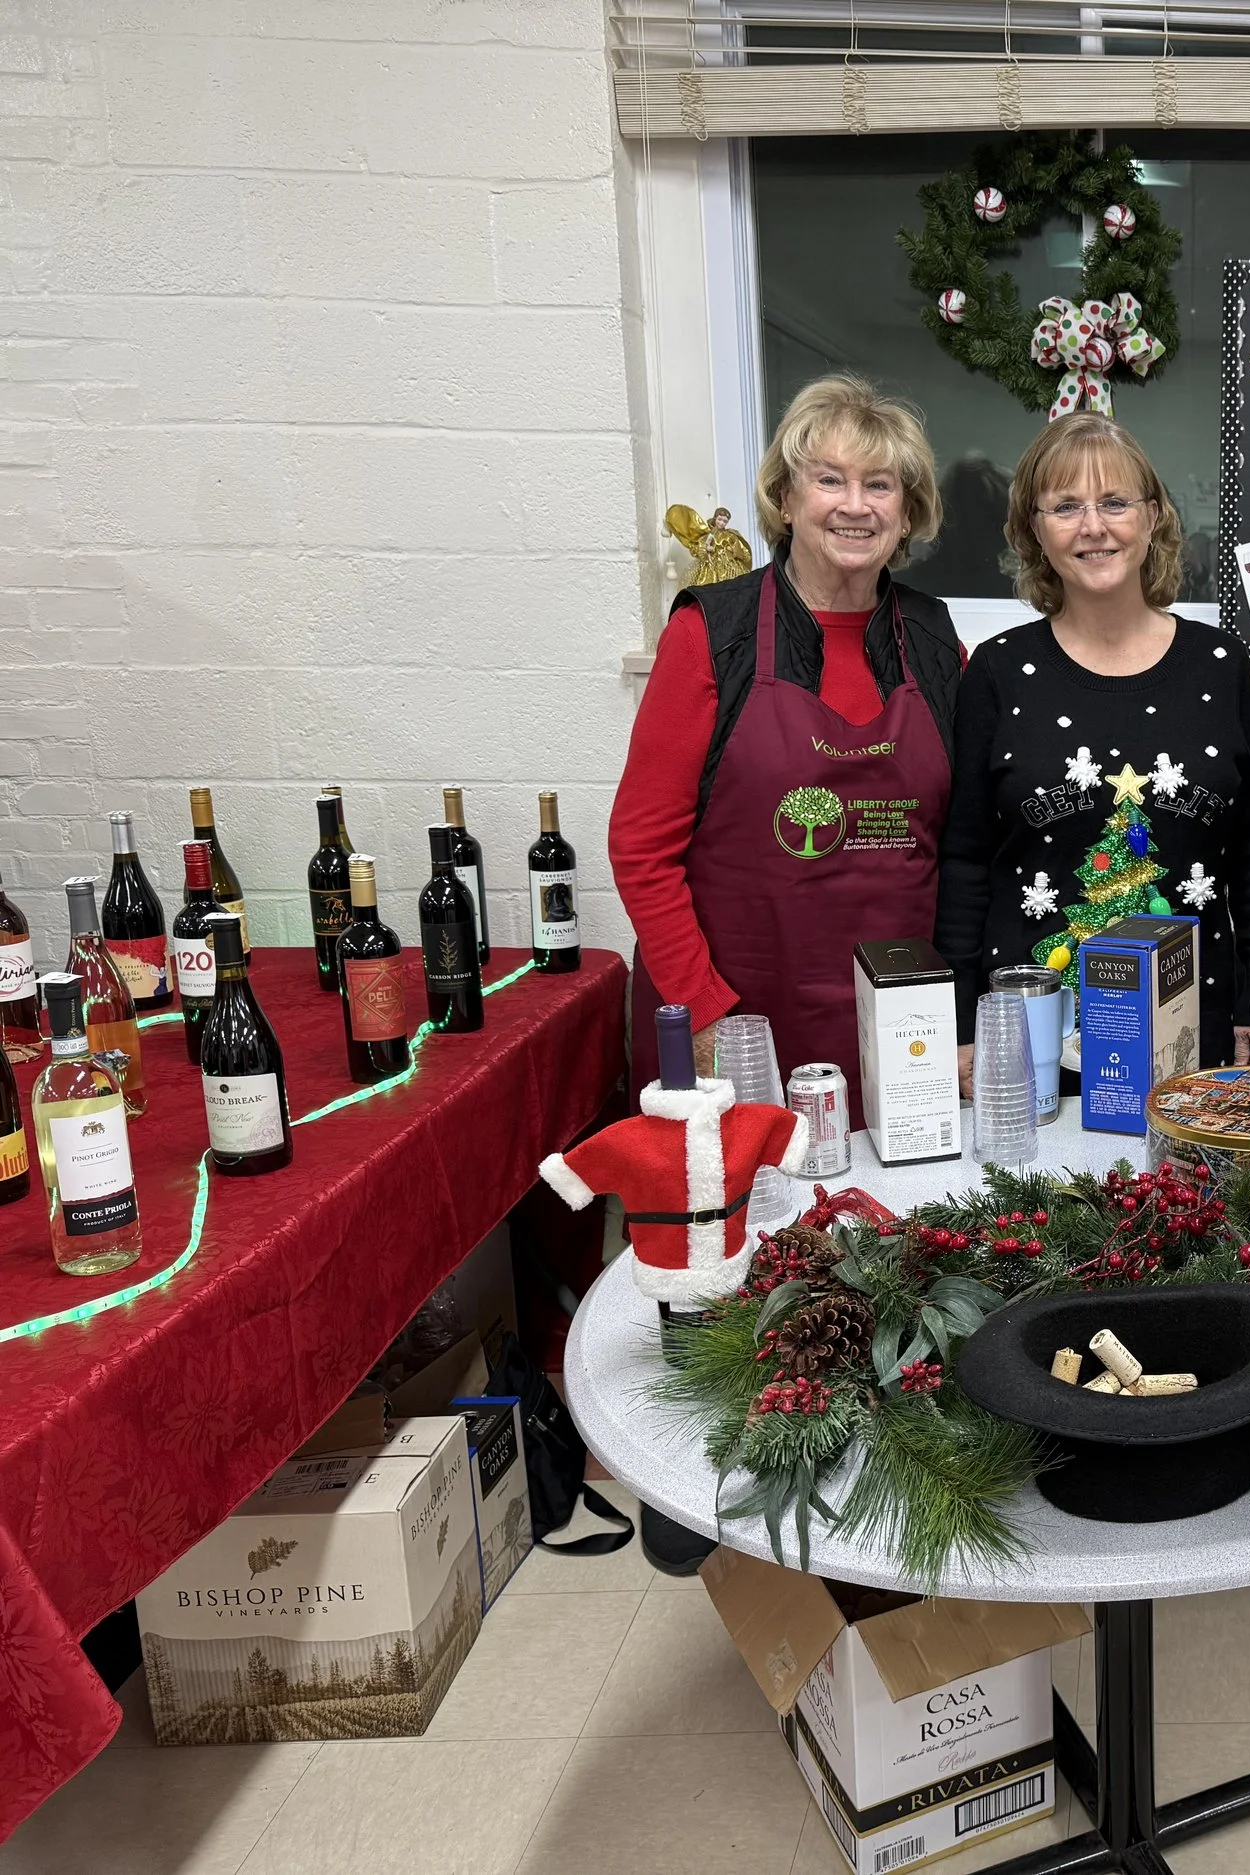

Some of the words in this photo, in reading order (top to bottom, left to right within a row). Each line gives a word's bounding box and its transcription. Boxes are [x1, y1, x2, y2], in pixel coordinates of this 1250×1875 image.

[812, 736, 897, 757] Volunteer
[847, 800, 886, 809] LIBERTY
[888, 799, 919, 808] GROVE:
[857, 820, 891, 829] Bringing
[863, 811, 886, 820] Being
[857, 828, 887, 836] Sharing
[893, 842, 916, 850] beyond
[551, 927, 576, 935] HANDS
[177, 951, 213, 971] 120
[1090, 960, 1134, 972] CANYON
[1160, 944, 1191, 973] CANYON
[1098, 971, 1127, 980] OAKS
[1166, 964, 1187, 986] OAKS
[895, 1028, 938, 1038] HECTARE
[228, 1094, 266, 1105] BREAK
[1038, 1094, 1057, 1106] YETI
[71, 1154, 94, 1163] PINOT
[95, 1147, 119, 1158] GRIGIO
[71, 1209, 103, 1221] CONTE
[105, 1201, 132, 1214] PRIOLA
[481, 1424, 513, 1470] CANYON
[489, 1445, 510, 1477] OAKS
[443, 1455, 462, 1490] PINE
[411, 1487, 442, 1541] BISHOP
[176, 1587, 284, 1607] BISHOP
[297, 1584, 365, 1603] PINE
[216, 1606, 329, 1617] VINEYARDS
[926, 1683, 986, 1714] CASA
[919, 1705, 993, 1743] ROSSA
[911, 1762, 1009, 1810] RIVATA
